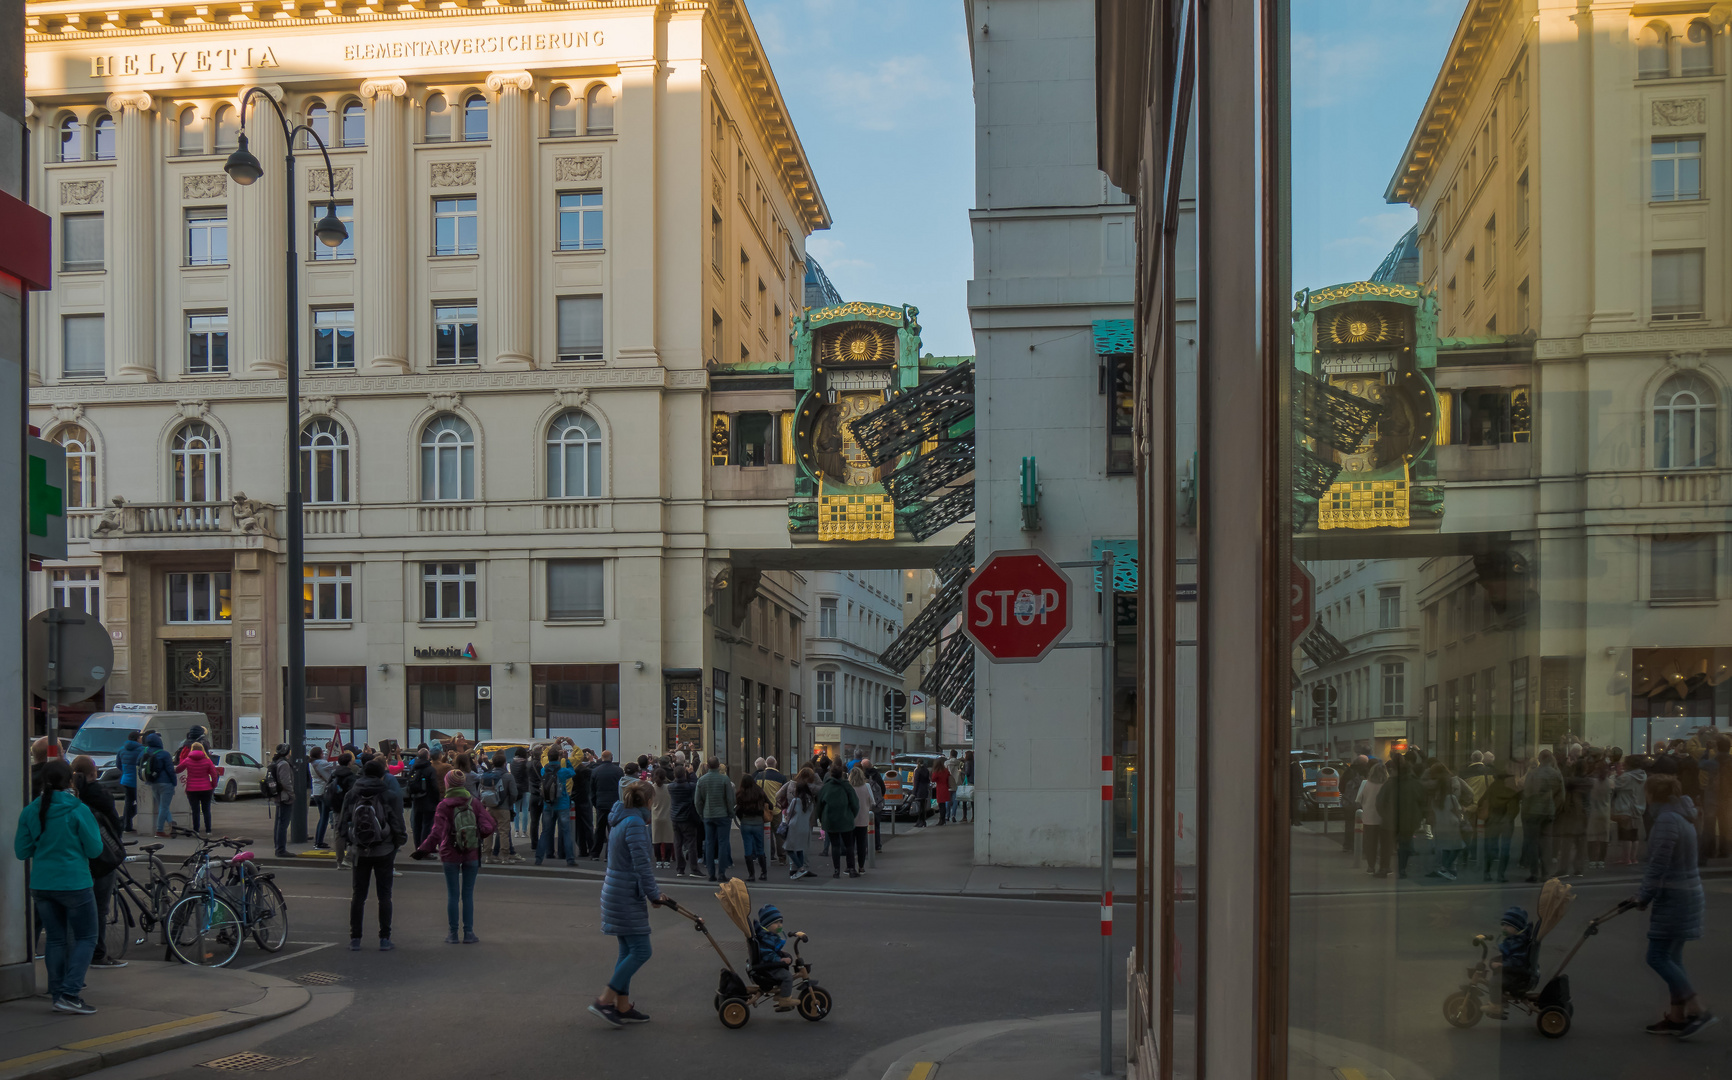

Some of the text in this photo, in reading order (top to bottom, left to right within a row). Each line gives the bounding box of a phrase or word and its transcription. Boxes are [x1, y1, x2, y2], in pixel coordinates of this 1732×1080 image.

[88, 30, 606, 79] HELVETIA ELEMENTARVERSICHERUNG
[842, 371, 850, 381] 15
[855, 371, 864, 381] 30
[868, 370, 878, 380] 45
[974, 588, 1060, 627] STOP
[413, 646, 461, 657] helvetia
